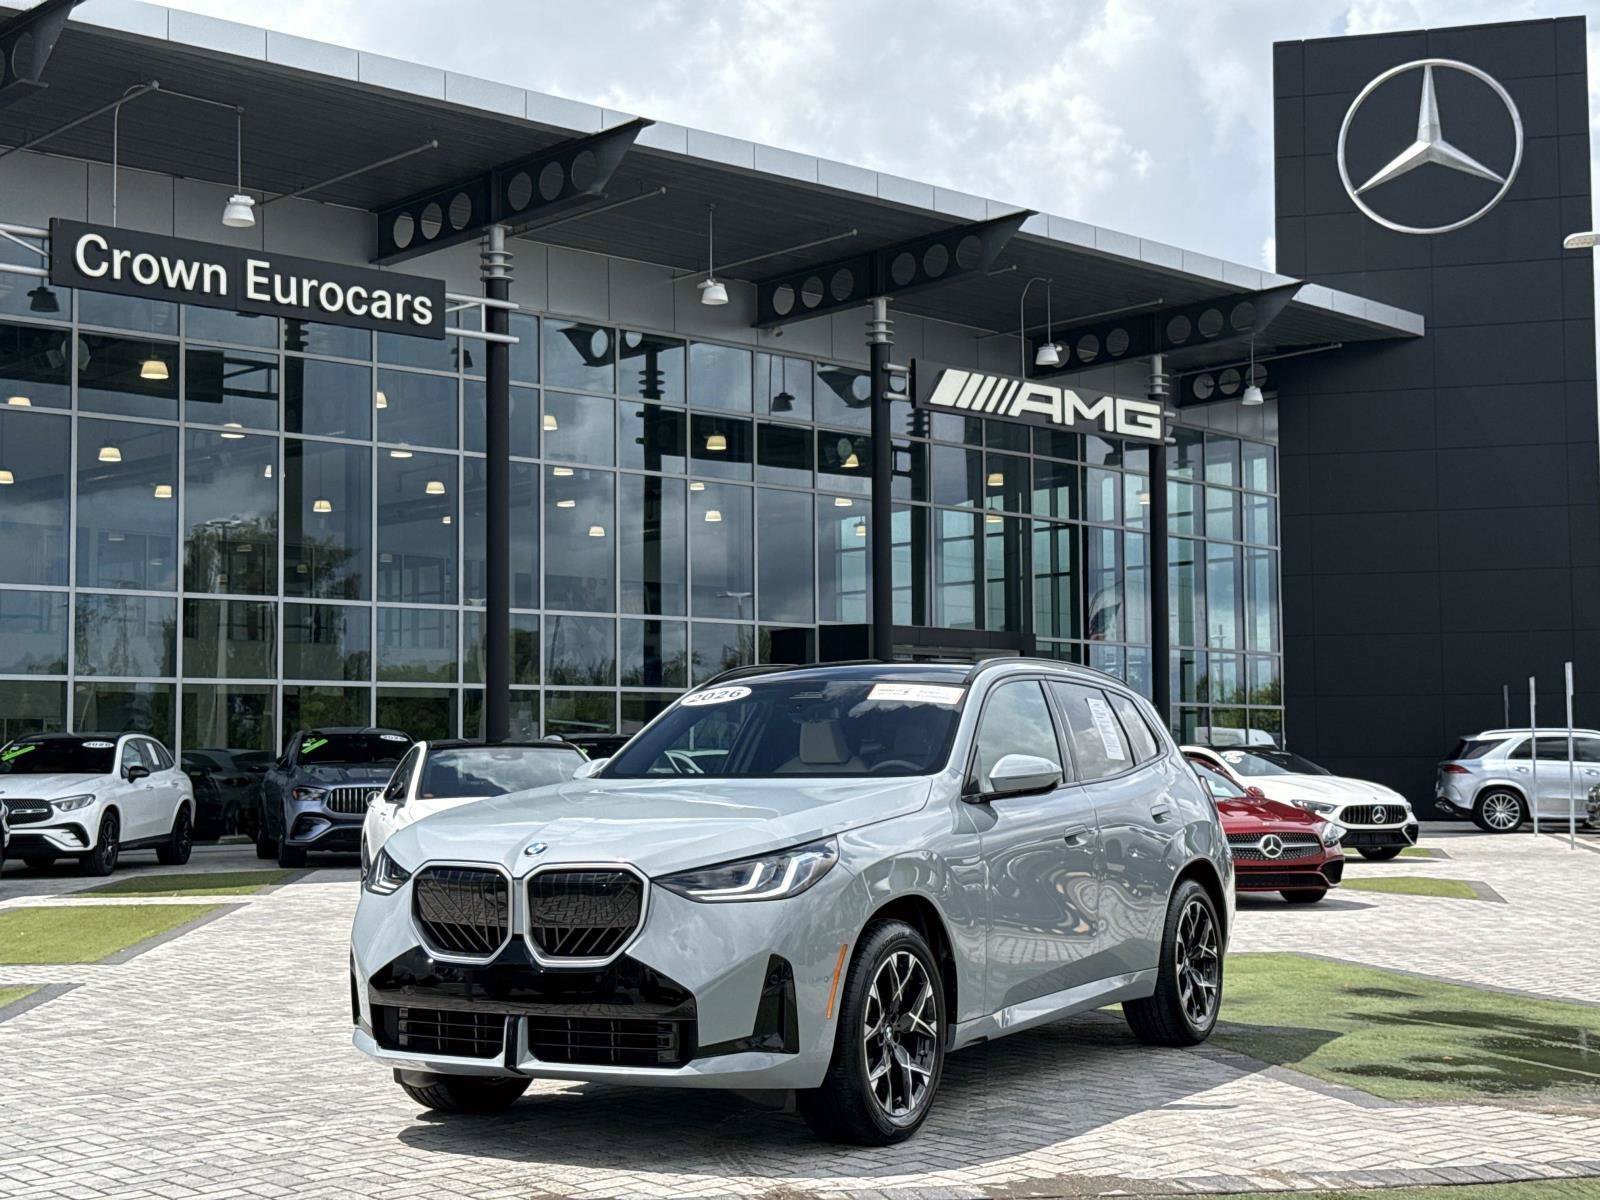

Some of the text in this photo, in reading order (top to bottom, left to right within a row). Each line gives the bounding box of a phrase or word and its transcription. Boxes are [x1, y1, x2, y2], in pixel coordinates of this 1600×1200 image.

[75, 233, 433, 326] Crown Eurocars
[1008, 381, 1161, 440] AMG
[685, 689, 745, 703] 2026
